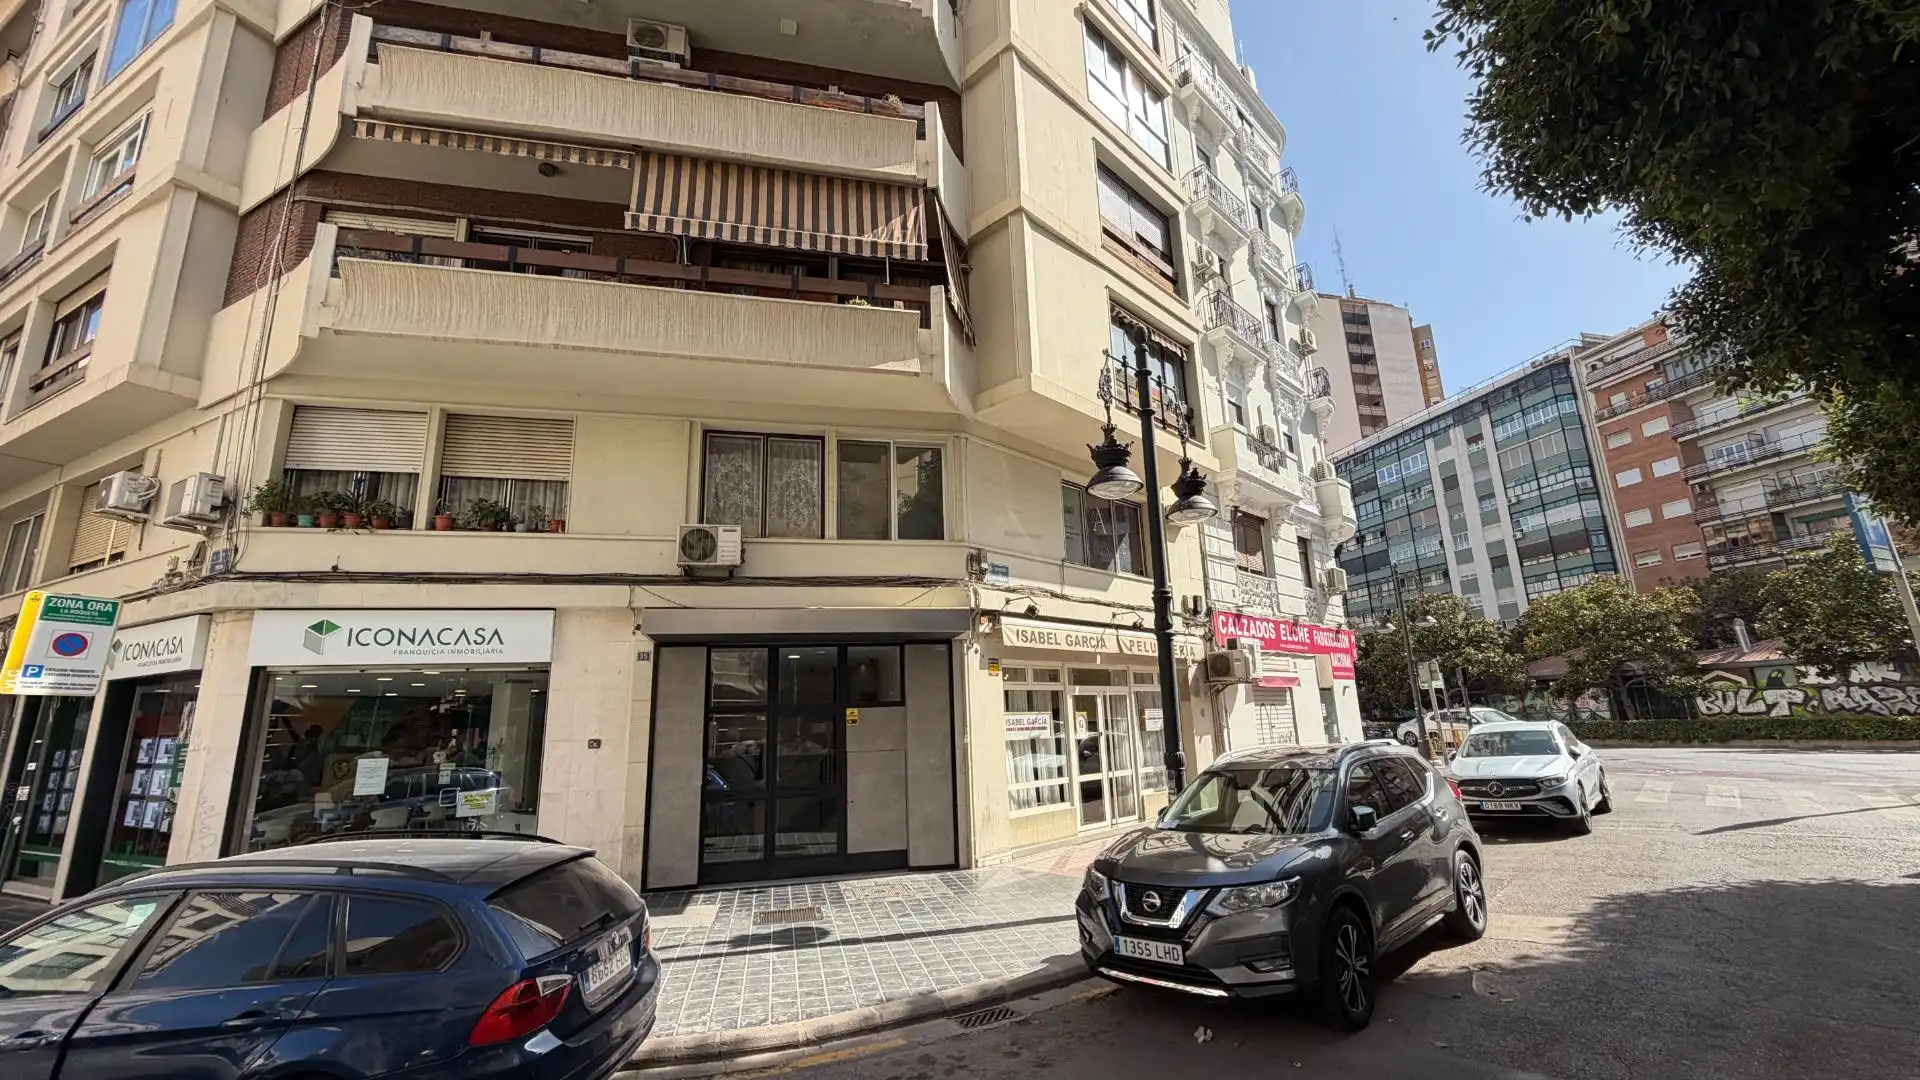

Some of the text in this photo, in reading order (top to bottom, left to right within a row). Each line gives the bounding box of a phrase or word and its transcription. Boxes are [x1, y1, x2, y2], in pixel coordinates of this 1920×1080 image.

[48, 597, 84, 610] ZONA
[87, 601, 113, 612] ORA
[347, 627, 504, 647] ICONACASA
[1016, 628, 1061, 646] ISABEL
[1219, 615, 1276, 639] CALZADOS
[1280, 624, 1311, 643] ELCHE
[121, 634, 183, 661] ICONACASA
[1006, 718, 1026, 726] ISABEL
[1123, 940, 1180, 962] 1355 LHD
